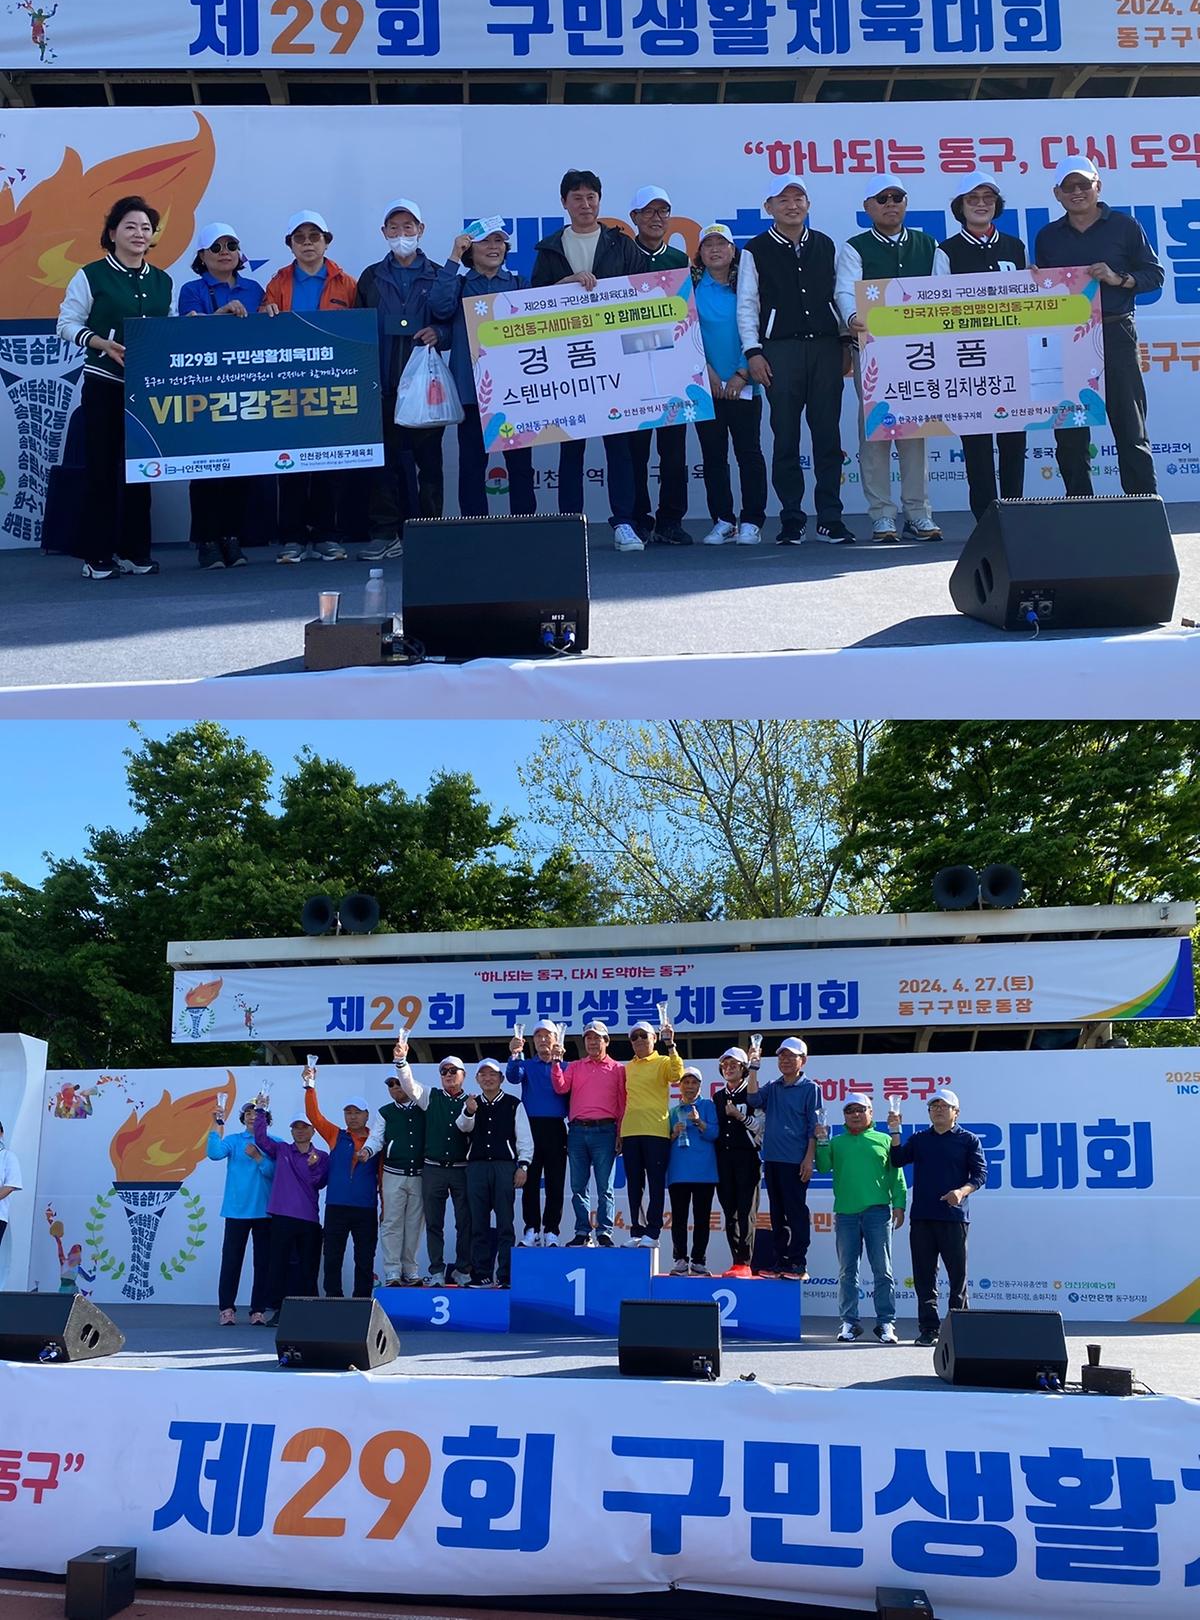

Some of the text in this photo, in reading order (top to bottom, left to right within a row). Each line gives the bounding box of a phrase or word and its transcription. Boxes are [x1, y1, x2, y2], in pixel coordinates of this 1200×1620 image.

[938, 137, 1028, 175] 동구,
[523, 286, 638, 313] 제29회 구민생활체육대회
[916, 283, 1040, 301] 제29회 구민생활체육대회
[169, 346, 334, 369] 제29회 구민생활체육대회
[148, 384, 359, 425] VIP건강검진권
[502, 372, 621, 407] 스텐바이미TV
[299, 447, 374, 461] 인천광역시동구체육회
[571, 968, 598, 982] 다시
[601, 966, 656, 980] 도약하는
[326, 992, 465, 1032] 제29회
[490, 979, 860, 1029] 구민생활체육대회
[899, 979, 948, 994] 2024.
[952, 978, 969, 993] 4.
[898, 998, 1034, 1017] 동구구민운동장
[565, 1268, 586, 1316] 1
[711, 1288, 739, 1327] 2
[430, 1295, 451, 1326] 3
[152, 1420, 555, 1552] 제29회
